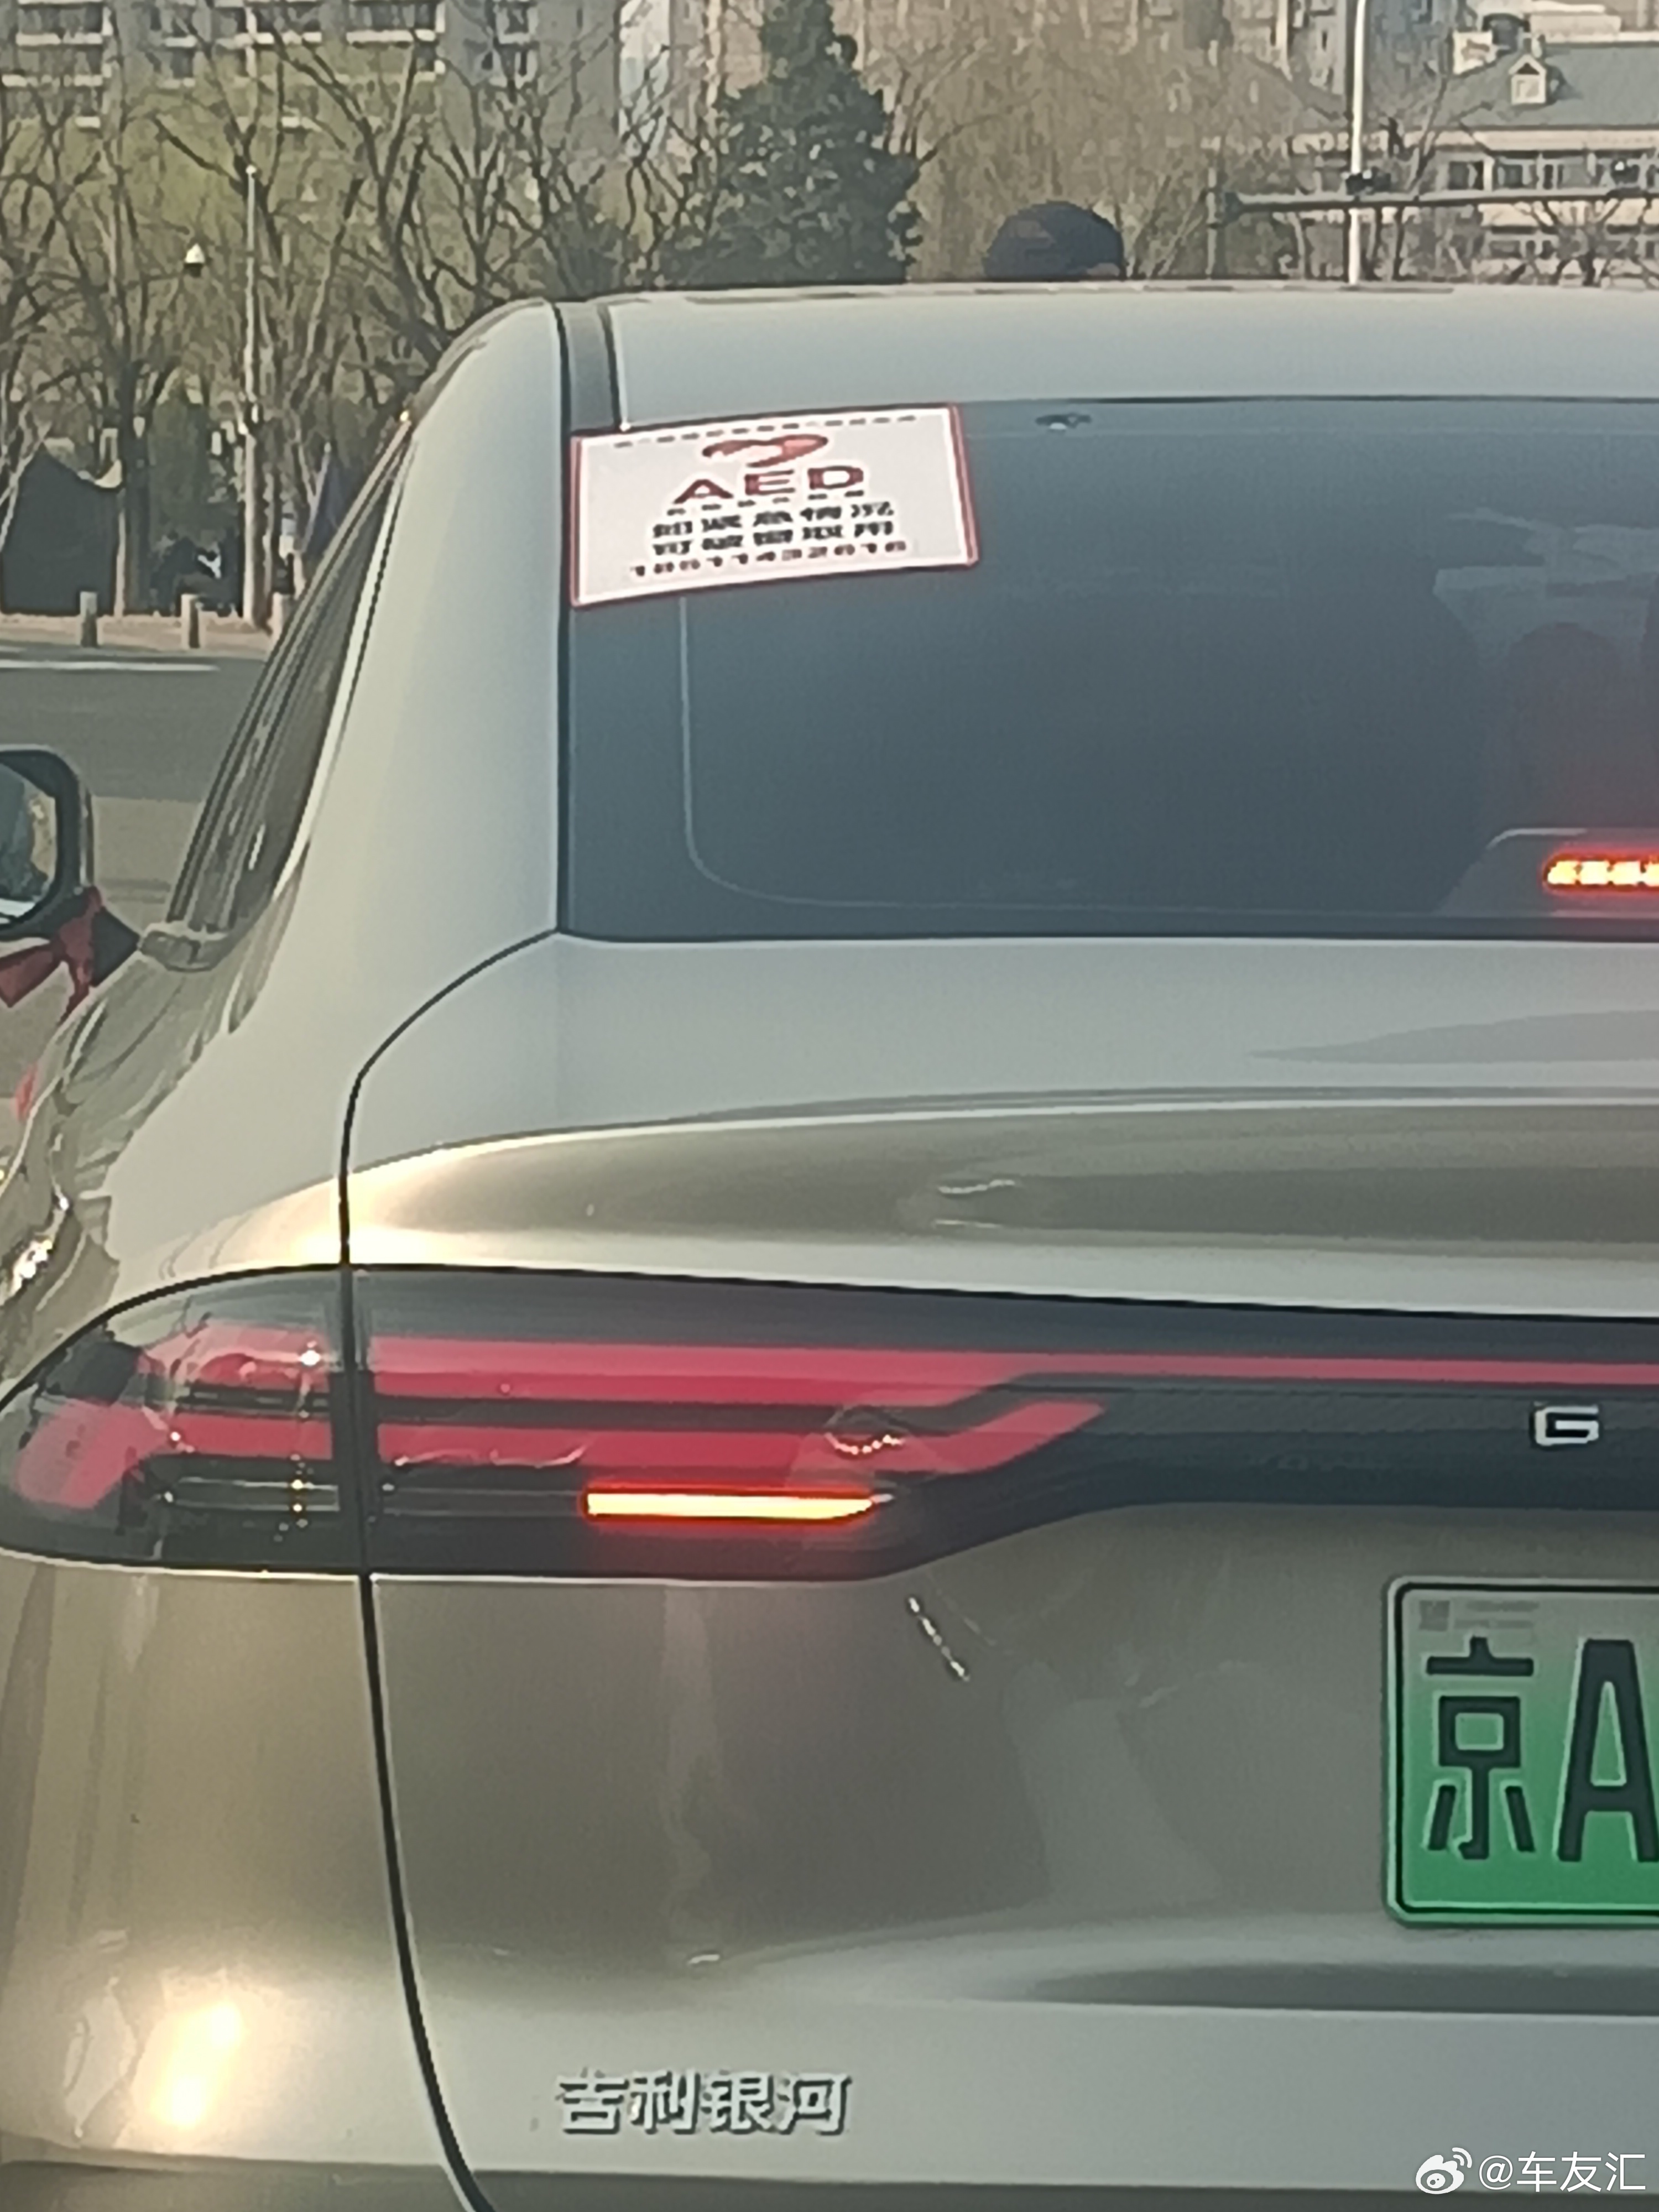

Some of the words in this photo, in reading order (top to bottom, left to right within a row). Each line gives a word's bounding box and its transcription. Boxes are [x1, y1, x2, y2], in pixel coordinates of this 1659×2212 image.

[671, 465, 864, 504] AED
[555, 2069, 852, 2136] 吉利银河
